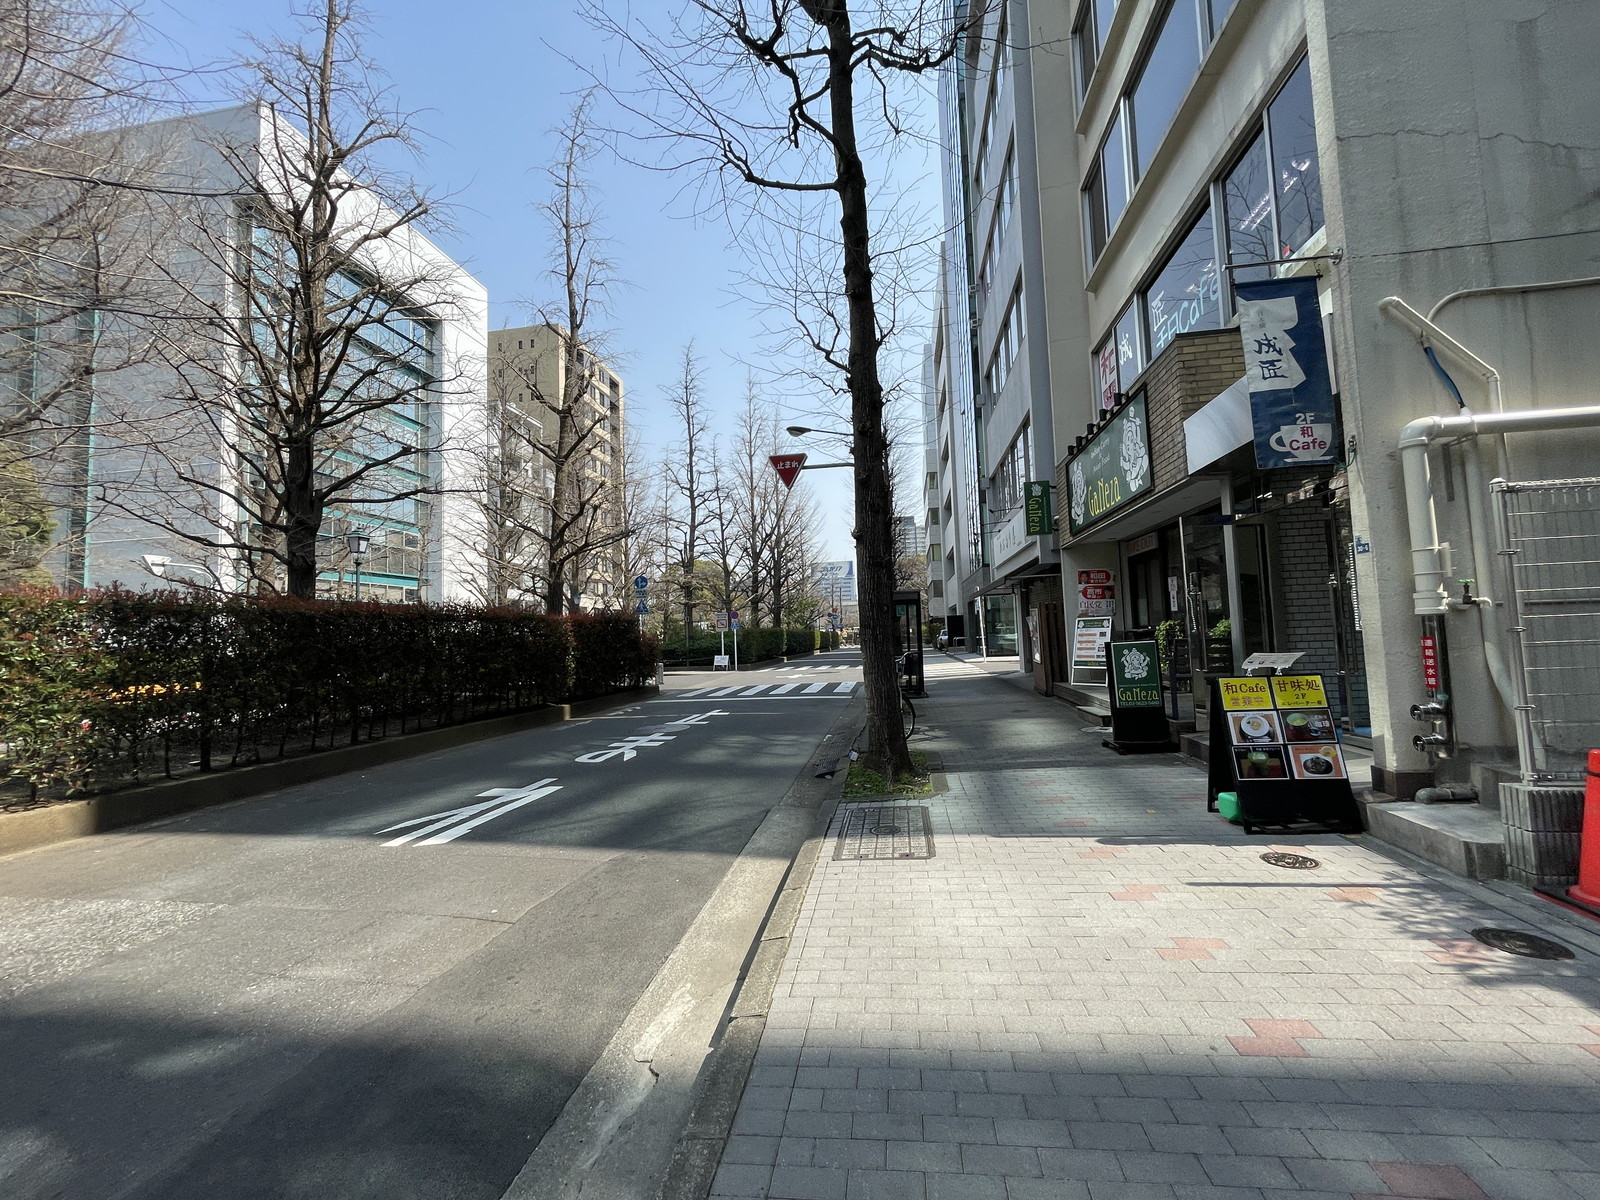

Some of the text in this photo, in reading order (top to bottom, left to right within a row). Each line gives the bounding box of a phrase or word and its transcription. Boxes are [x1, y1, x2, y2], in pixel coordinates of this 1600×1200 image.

[1295, 412, 1315, 425] 2F
[1300, 426, 1314, 438] 和
[1288, 438, 1327, 452] Cafe
[776, 460, 799, 470] 止まれ
[1276, 679, 1320, 692] 甘味処
